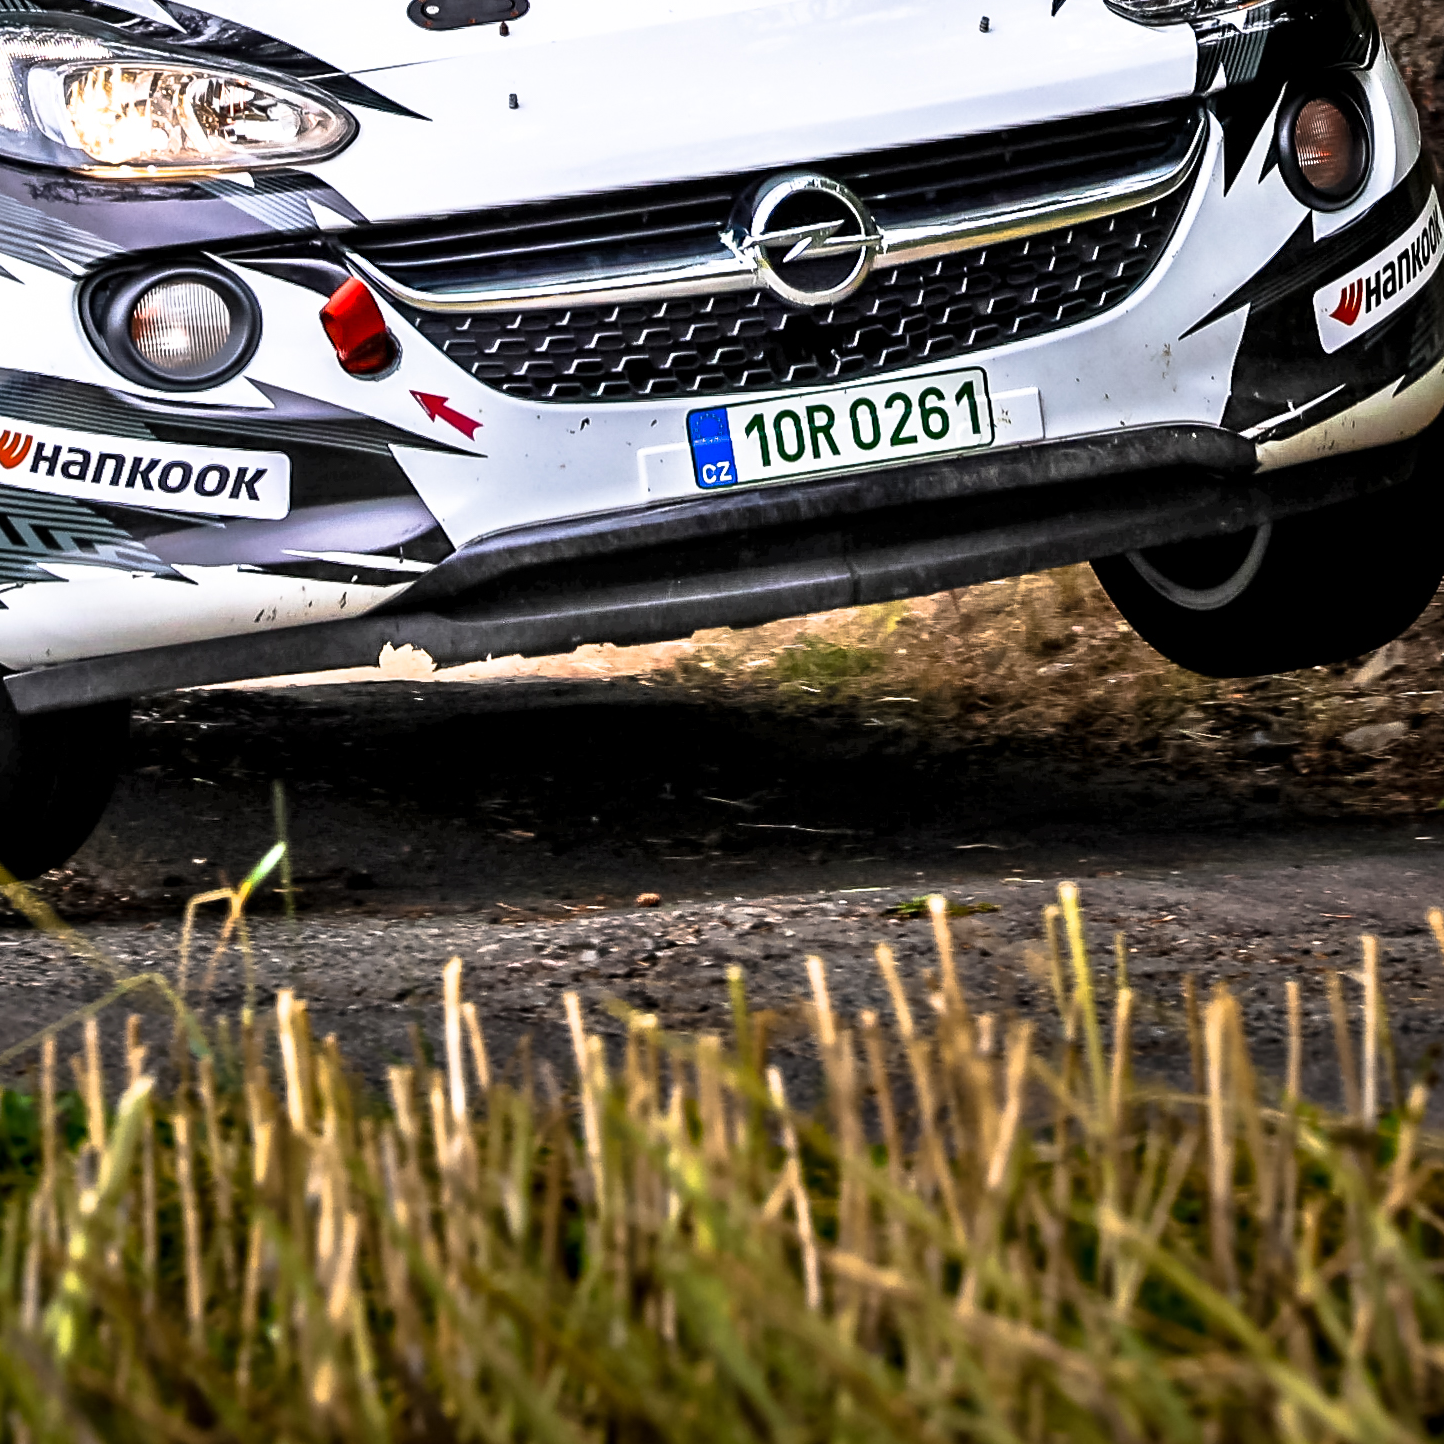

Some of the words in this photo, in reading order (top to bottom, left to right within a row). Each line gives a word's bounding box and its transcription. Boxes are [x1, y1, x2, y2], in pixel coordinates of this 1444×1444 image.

[744, 404, 841, 467] 10R
[849, 380, 981, 451] 0261
[702, 461, 732, 484] CZ
